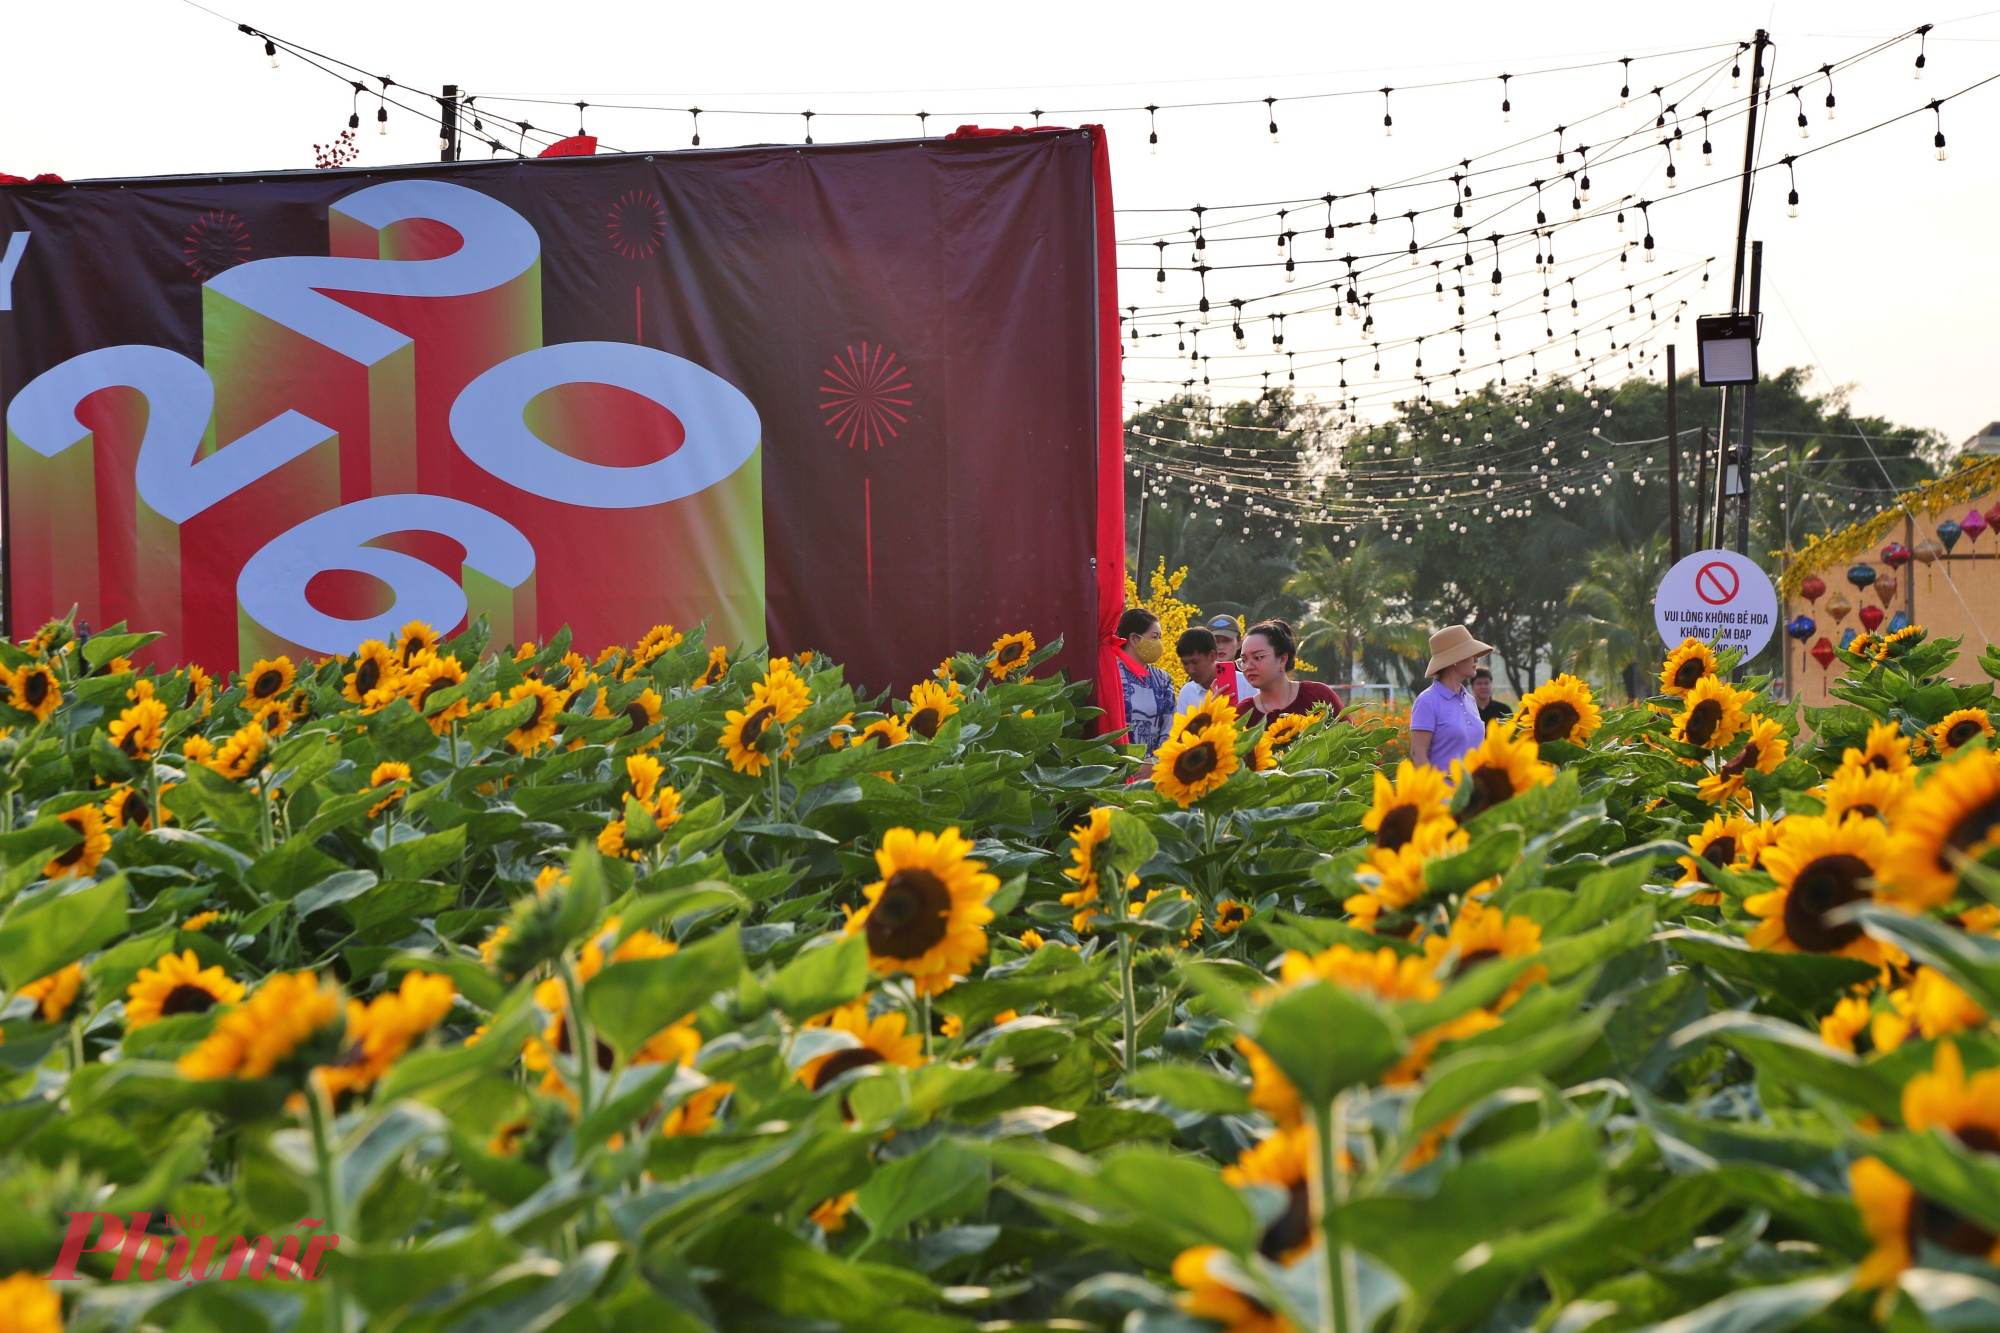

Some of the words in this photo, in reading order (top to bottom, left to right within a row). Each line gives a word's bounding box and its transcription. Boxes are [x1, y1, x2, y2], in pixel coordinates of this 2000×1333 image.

[1664, 610, 1679, 622] VUI
[1680, 609, 1703, 623] LÒNG
[1705, 611, 1735, 624] KHÔNG
[1737, 610, 1749, 624] BẺ
[1750, 614, 1769, 625] HOA
[1680, 625, 1710, 639] KHÔNG
[1712, 624, 1732, 640] DM
[1734, 629, 1752, 642] ĐẠP
